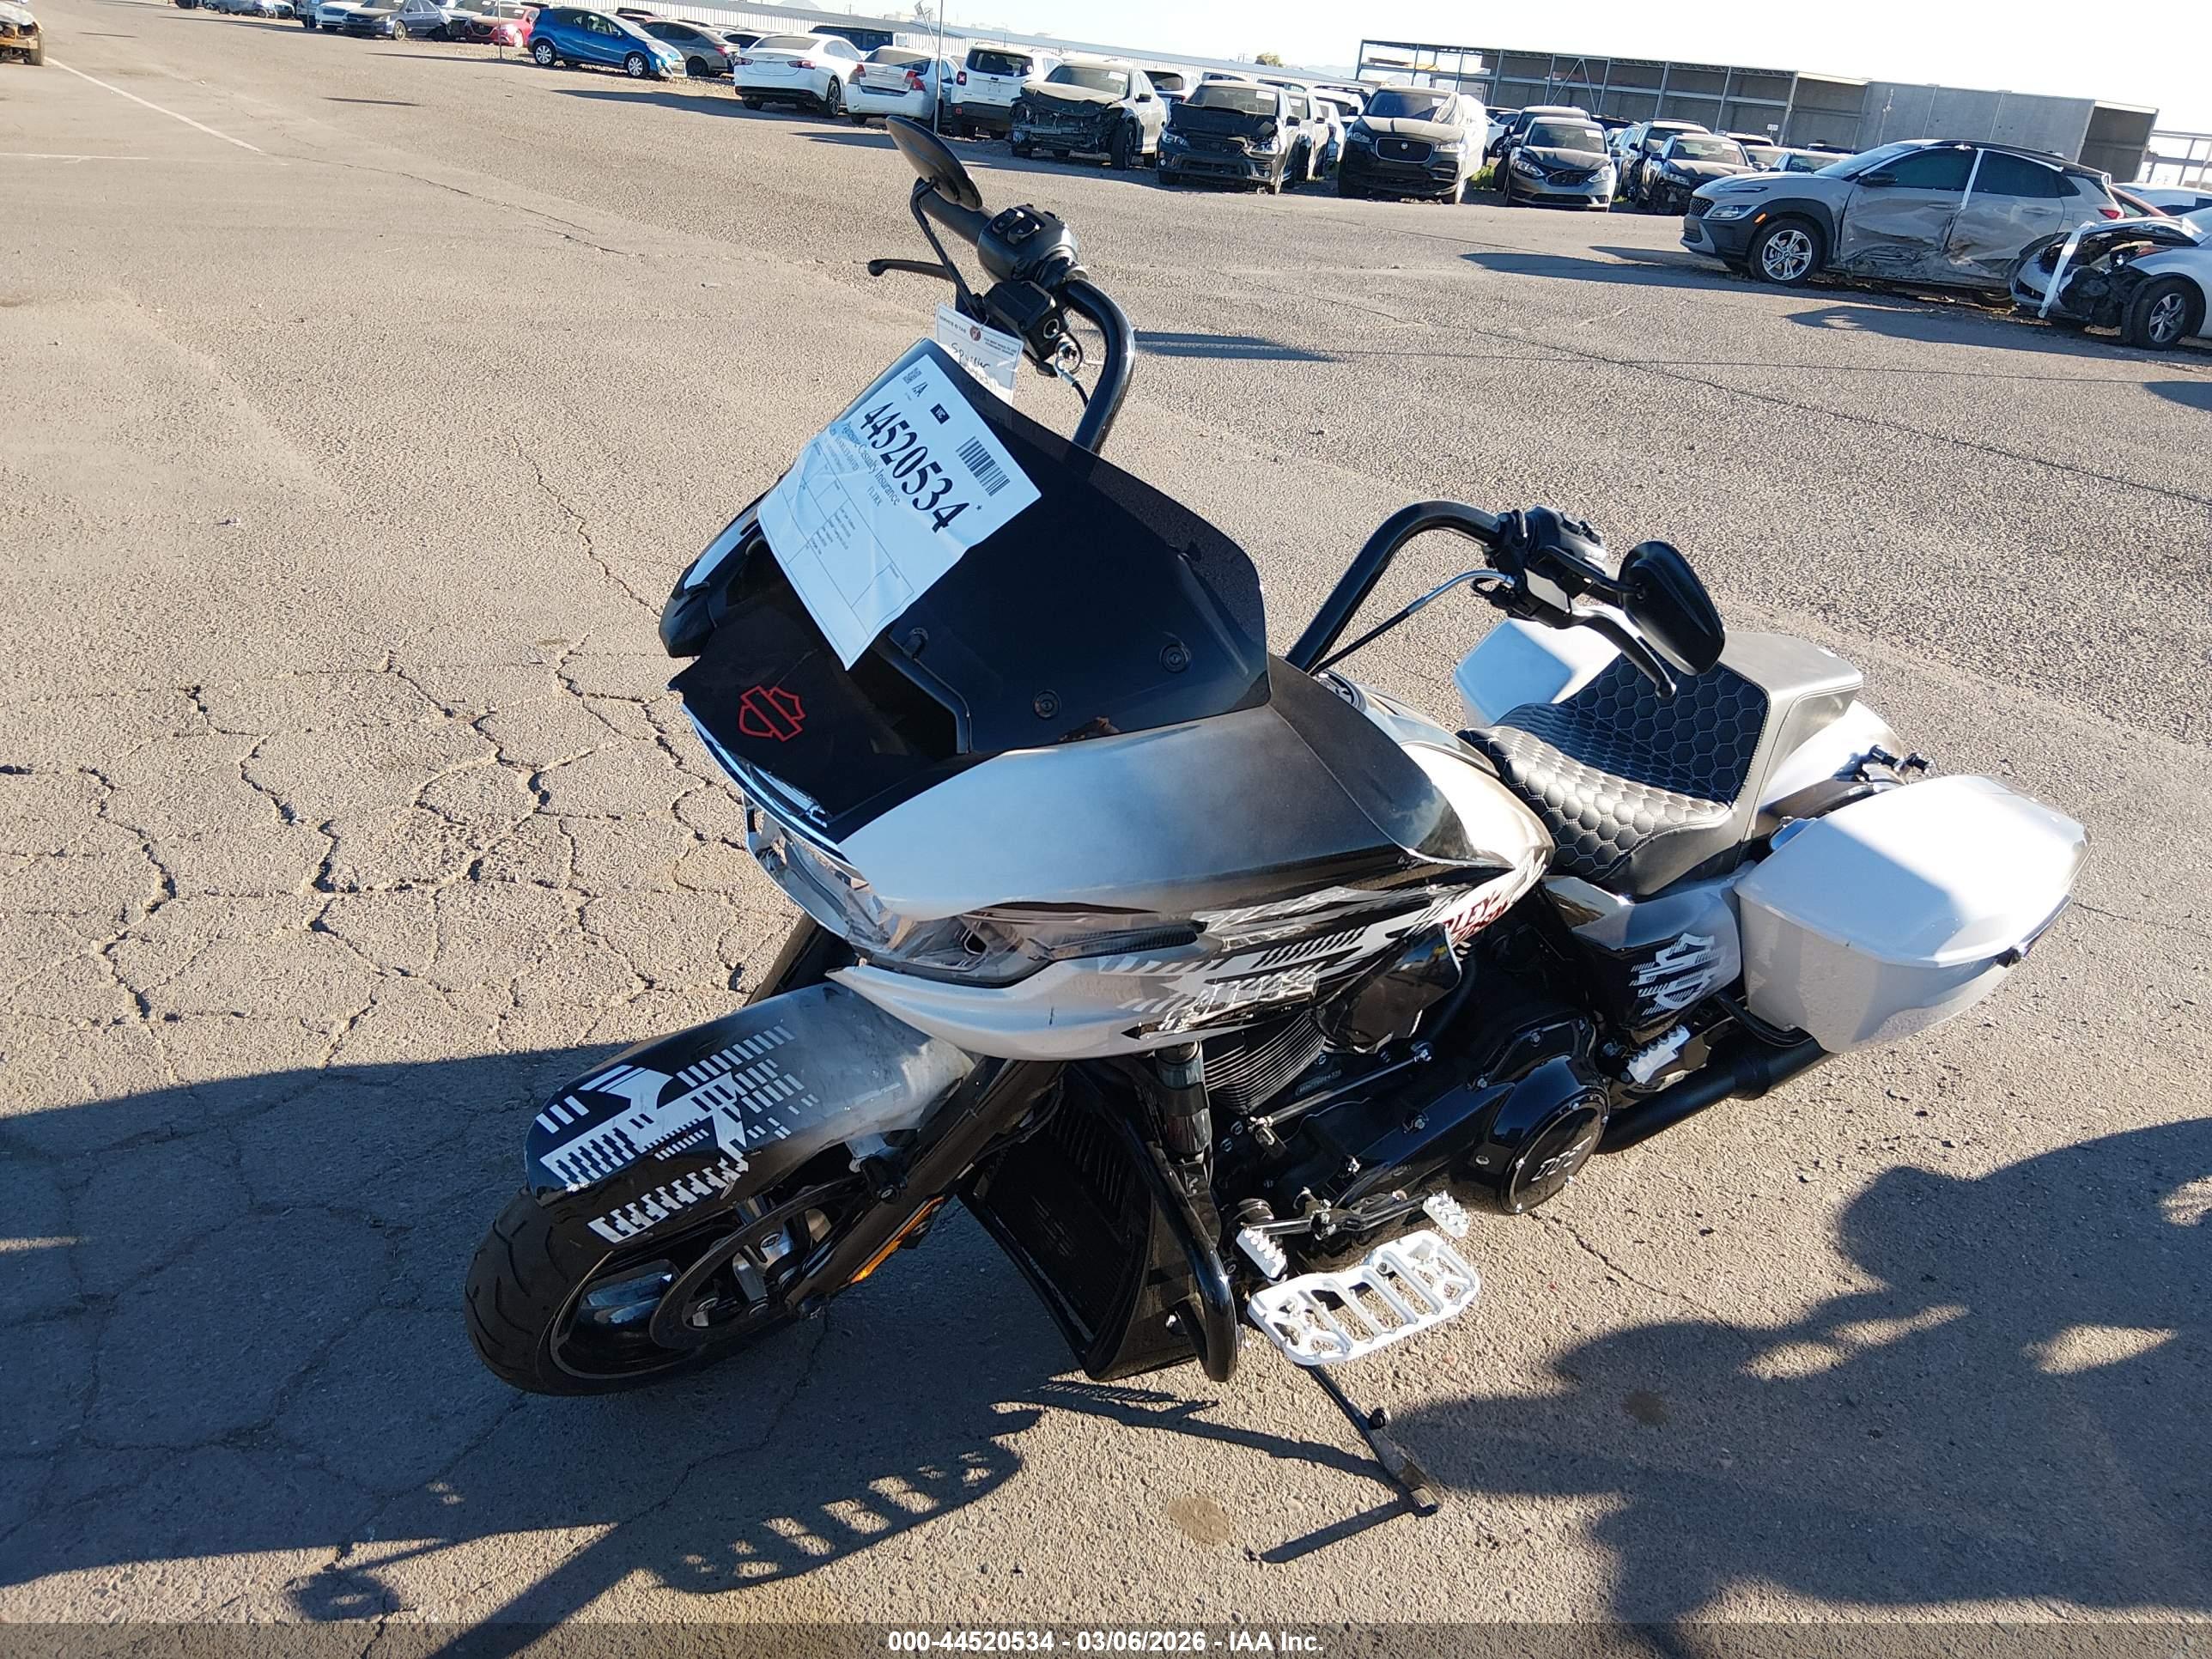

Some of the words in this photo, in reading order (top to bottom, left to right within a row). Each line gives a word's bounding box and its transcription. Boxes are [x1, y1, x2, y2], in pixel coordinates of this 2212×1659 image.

[859, 444, 878, 475] Casualty
[874, 469, 901, 507] Insurance
[860, 402, 969, 532] 44520534
